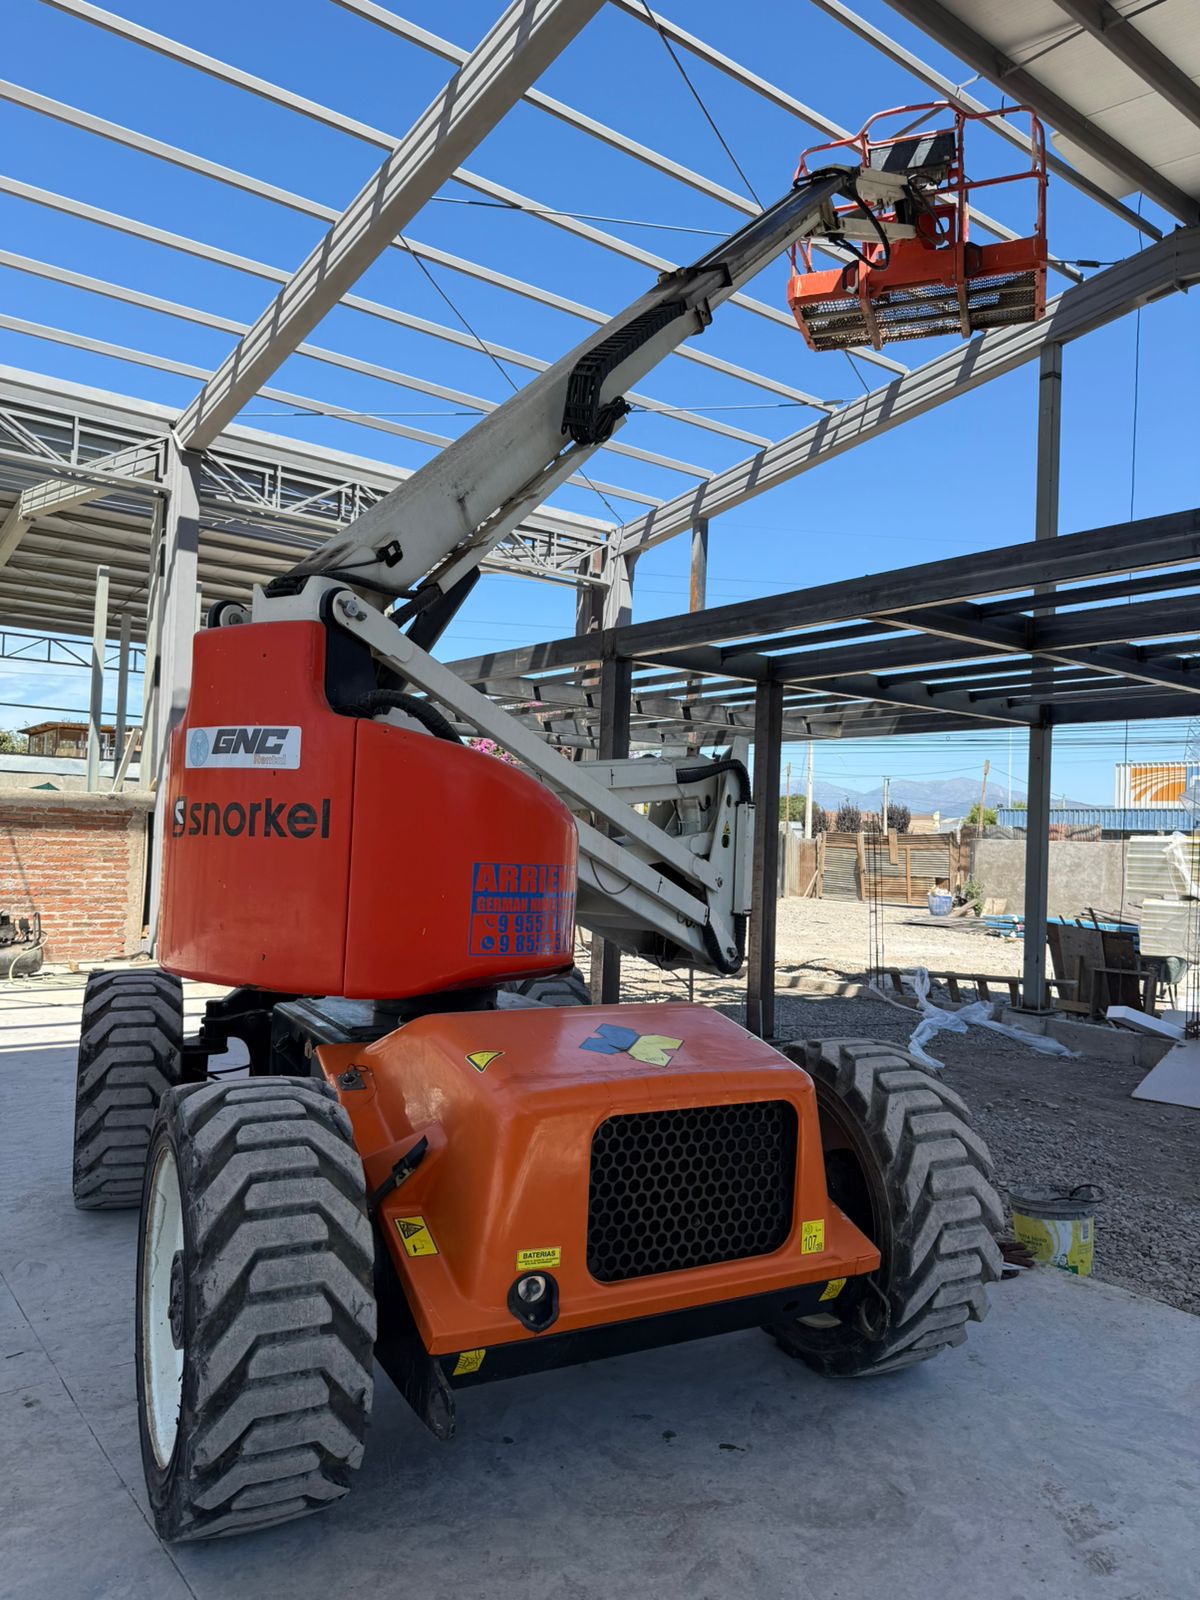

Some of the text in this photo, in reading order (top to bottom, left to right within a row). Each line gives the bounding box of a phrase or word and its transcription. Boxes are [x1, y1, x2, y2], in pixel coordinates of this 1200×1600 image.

[211, 728, 289, 755] GNC
[189, 798, 331, 839] snorkel
[804, 1235, 817, 1250] 107
[522, 1250, 556, 1259] BATERIAS
